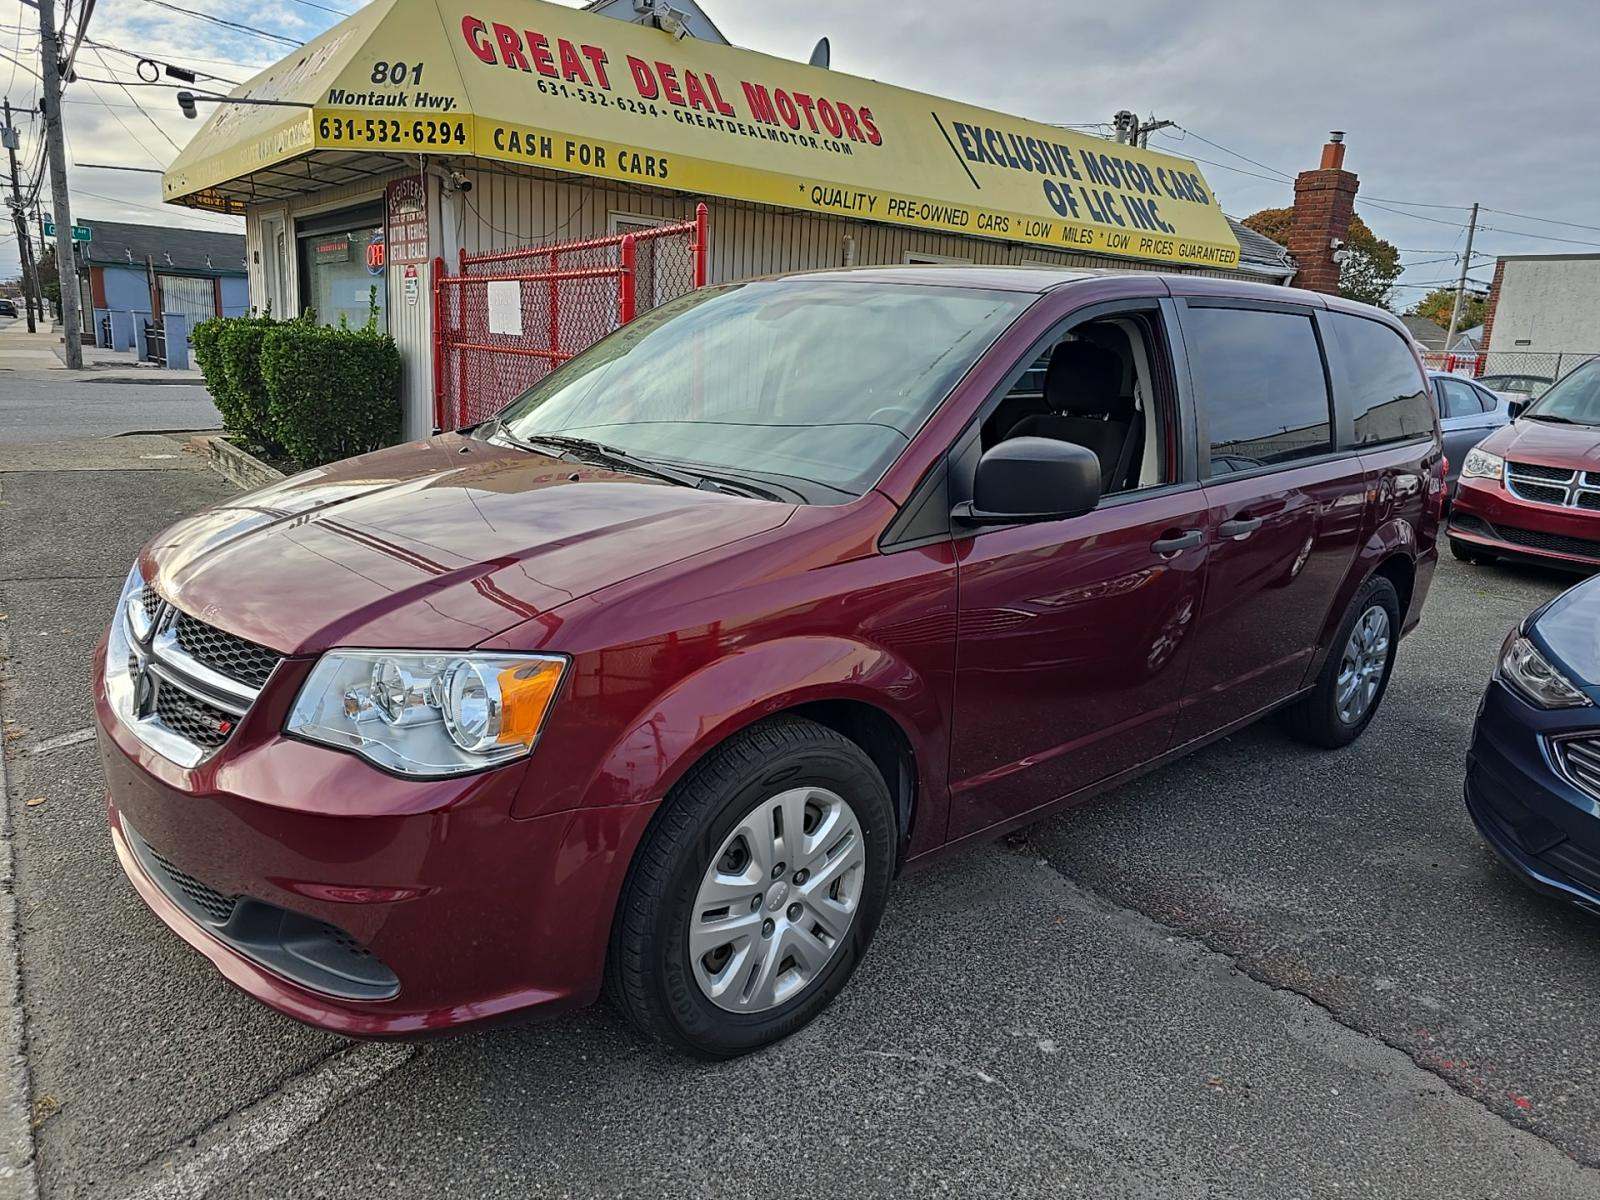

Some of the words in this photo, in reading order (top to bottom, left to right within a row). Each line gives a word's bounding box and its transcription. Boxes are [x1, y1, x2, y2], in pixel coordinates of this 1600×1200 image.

[328, 89, 408, 107] Montauk
[415, 92, 457, 111] Hwy.
[370, 61, 424, 85] 801
[461, 15, 611, 90] GREAT
[626, 55, 736, 118] DEAL
[740, 81, 883, 146] MOTORS
[319, 118, 466, 145] 631-532-6294
[537, 80, 658, 117] 631-532-6294
[674, 110, 853, 155] GREATDEALMOTOR.COM
[493, 128, 552, 159] CASH
[565, 141, 606, 168] FOR
[618, 151, 668, 178] CARS
[952, 121, 1082, 181] EXCLUSIVE
[1079, 149, 1162, 197] MOTOR
[1157, 167, 1210, 206] CARS
[811, 185, 877, 213] QUALITY
[888, 198, 969, 227] PRE-OWNED
[977, 213, 1010, 233] CARS
[1025, 220, 1052, 239] LOW
[1062, 226, 1094, 245] MILES
[1107, 232, 1131, 250] LOW
[1139, 238, 1174, 256] PRICES
[1179, 243, 1236, 264] GUARANTEED
[1042, 178, 1080, 218] OF
[1079, 186, 1126, 227] LIC
[1120, 194, 1176, 235] INC.
